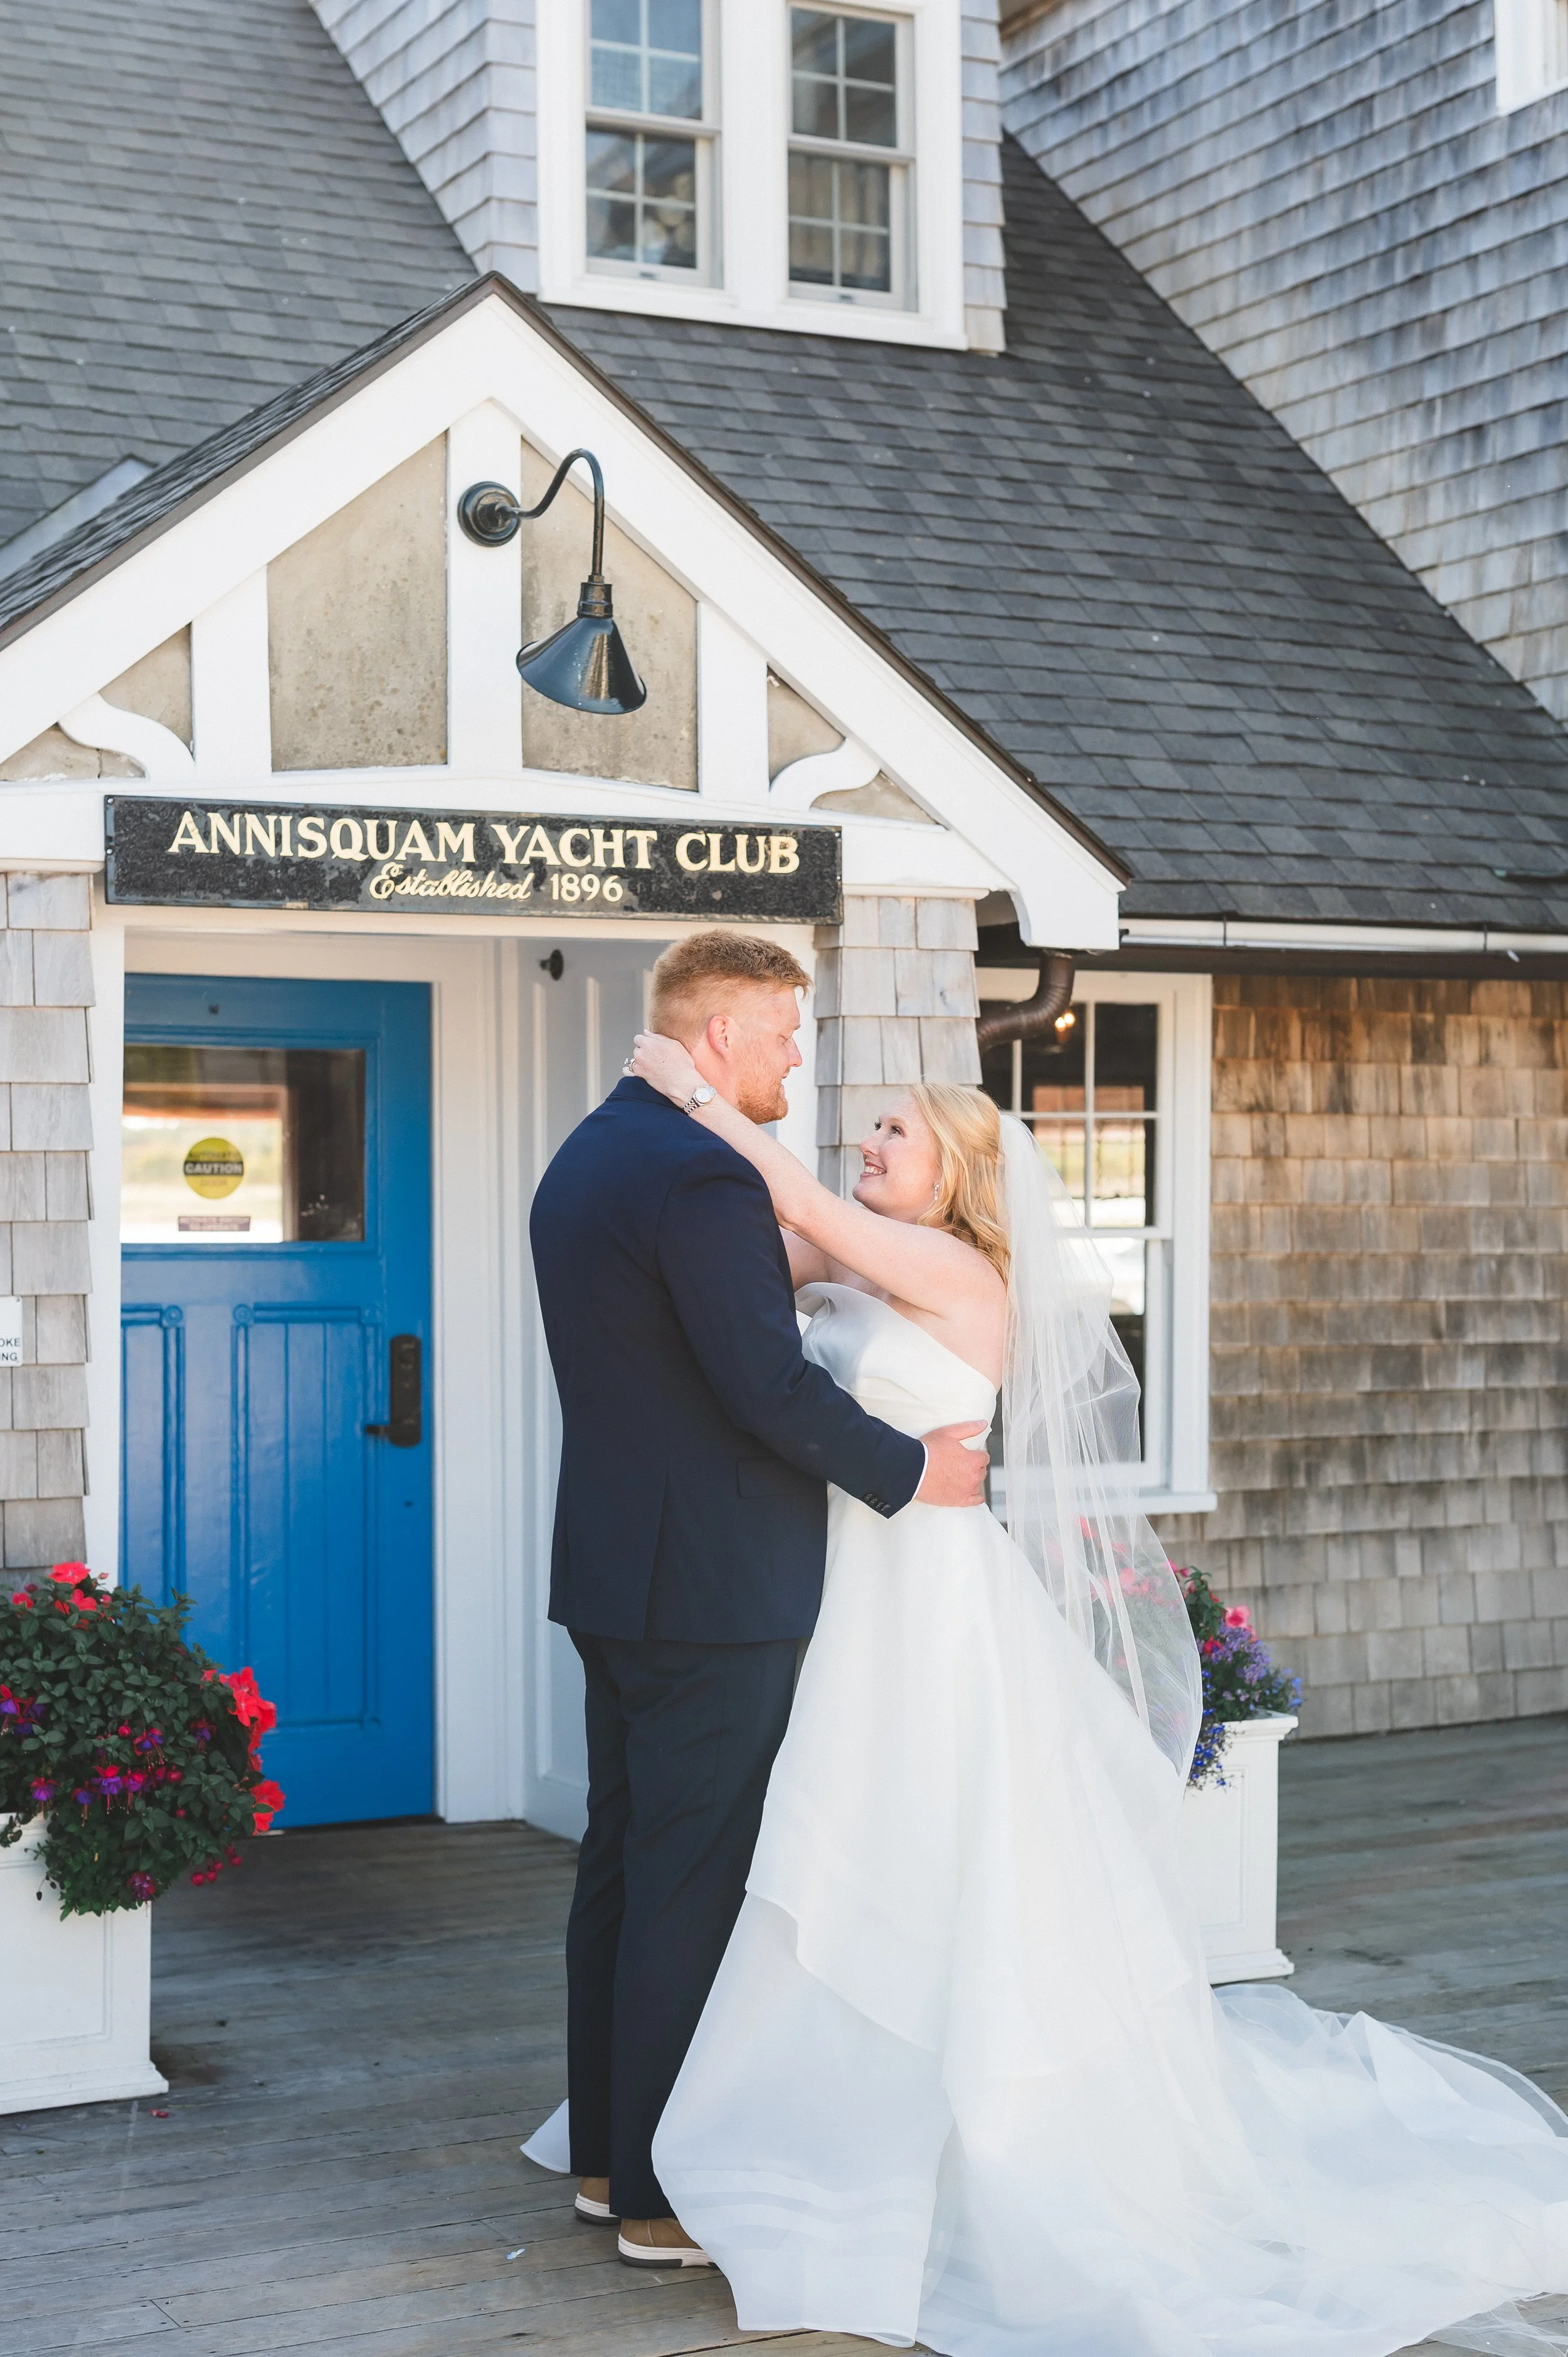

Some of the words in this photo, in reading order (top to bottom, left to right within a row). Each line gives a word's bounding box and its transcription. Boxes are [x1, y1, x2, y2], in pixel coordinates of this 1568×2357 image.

[167, 810, 476, 862] ANNISQUAM
[490, 824, 658, 869] YACHT
[675, 830, 800, 874] CLUB
[369, 862, 535, 899] Established
[549, 873, 623, 903] 1896
[186, 1162, 243, 1175] CAUTION
